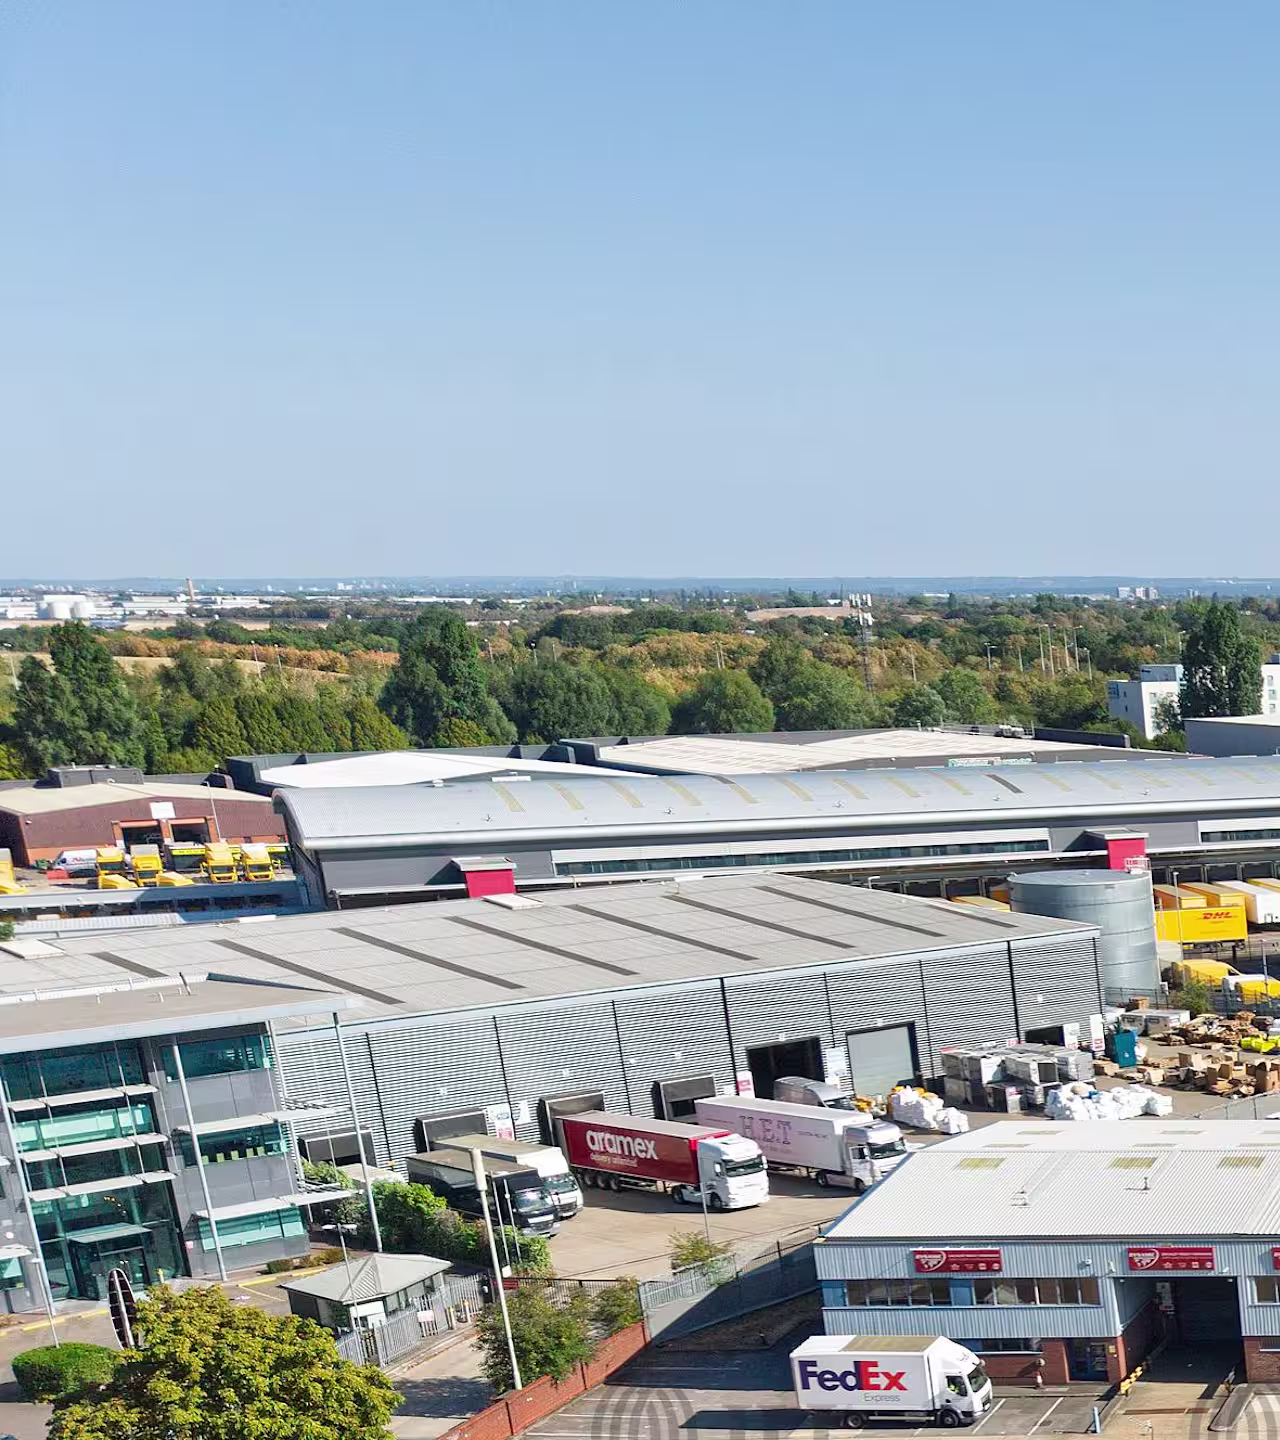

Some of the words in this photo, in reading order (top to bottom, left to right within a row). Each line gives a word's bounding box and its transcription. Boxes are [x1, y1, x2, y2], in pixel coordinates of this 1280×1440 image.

[1202, 911, 1233, 920] DHL
[586, 1130, 659, 1160] aramex
[799, 1361, 907, 1391] FedEx
[864, 1392, 901, 1402] Express
